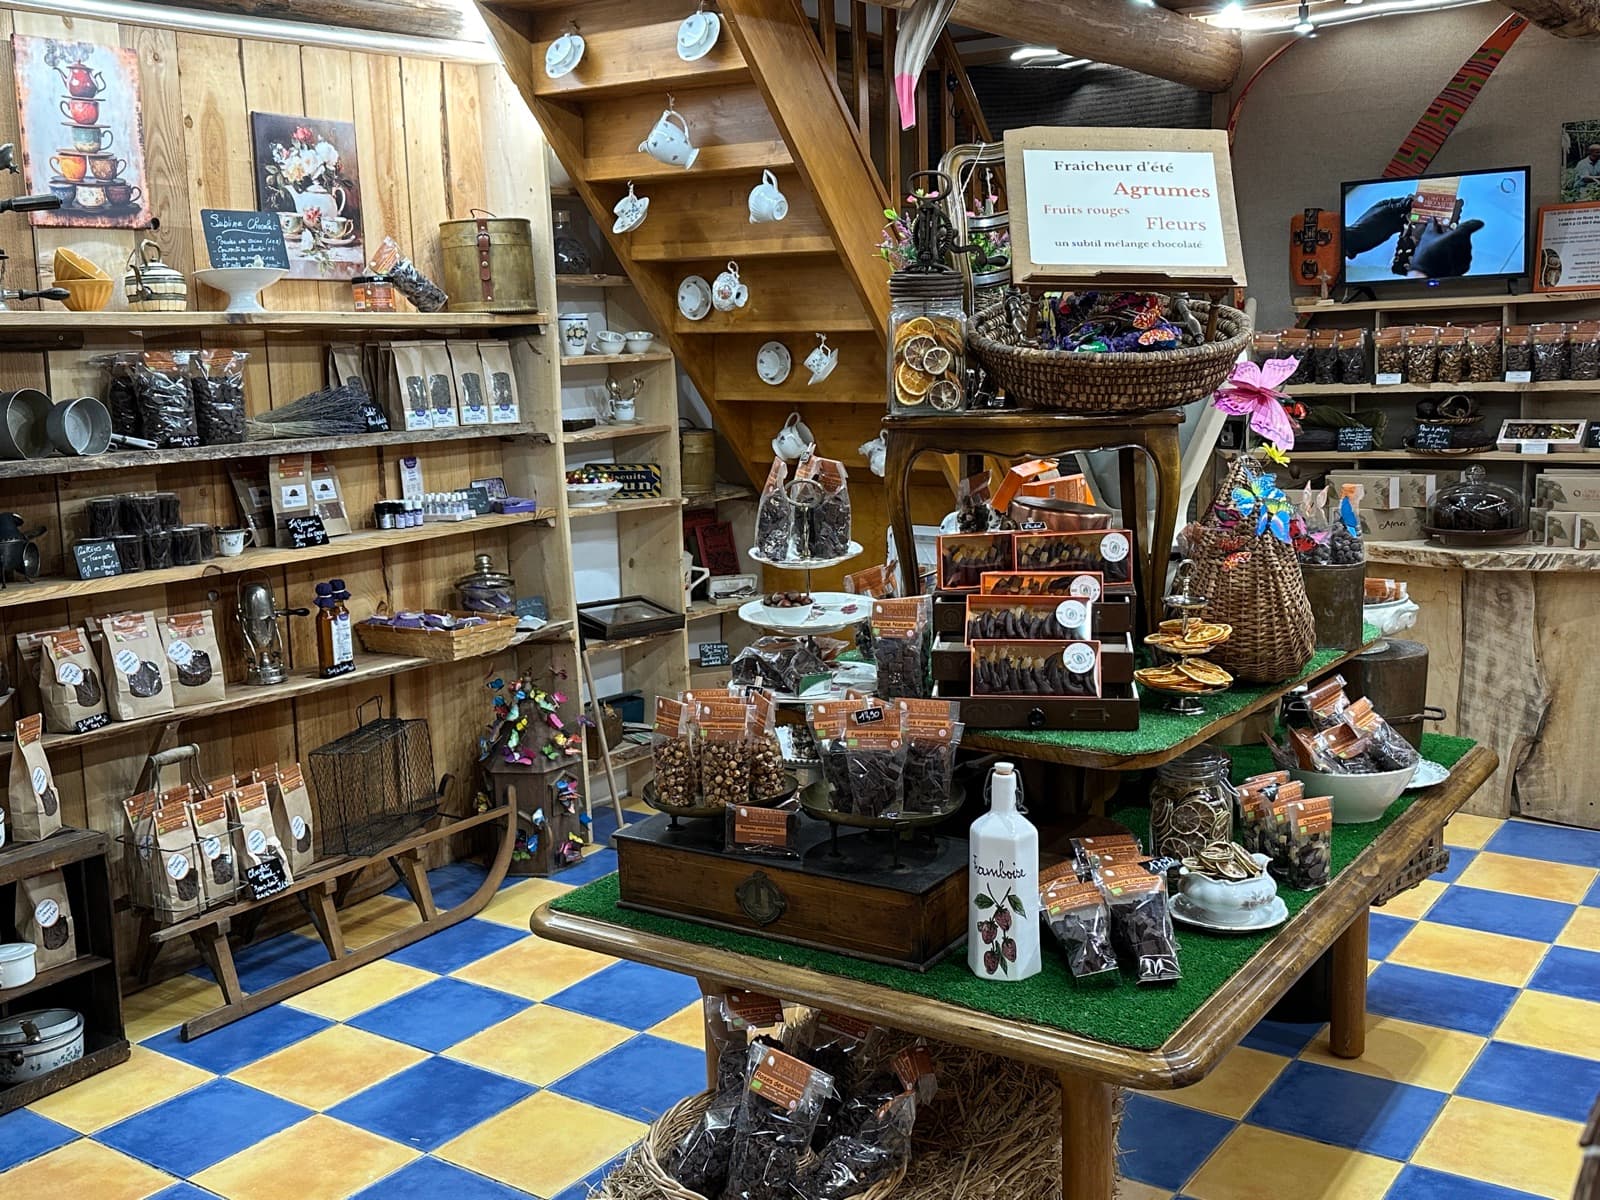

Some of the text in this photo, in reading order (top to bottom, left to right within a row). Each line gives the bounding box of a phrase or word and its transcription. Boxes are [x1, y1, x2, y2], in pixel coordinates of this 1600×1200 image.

[1054, 160, 1174, 173] Fraicheur d'été
[1113, 182, 1211, 199] Agrumes
[1043, 204, 1130, 218] Fruits rouges
[1146, 216, 1207, 231] Fleurs
[1104, 240, 1150, 249] mélange
[1151, 240, 1203, 249] chocolaté
[611, 473, 647, 481] iscuits
[623, 481, 652, 491] un
[756, 1071, 773, 1087] Roses
[773, 1079, 785, 1090] des
